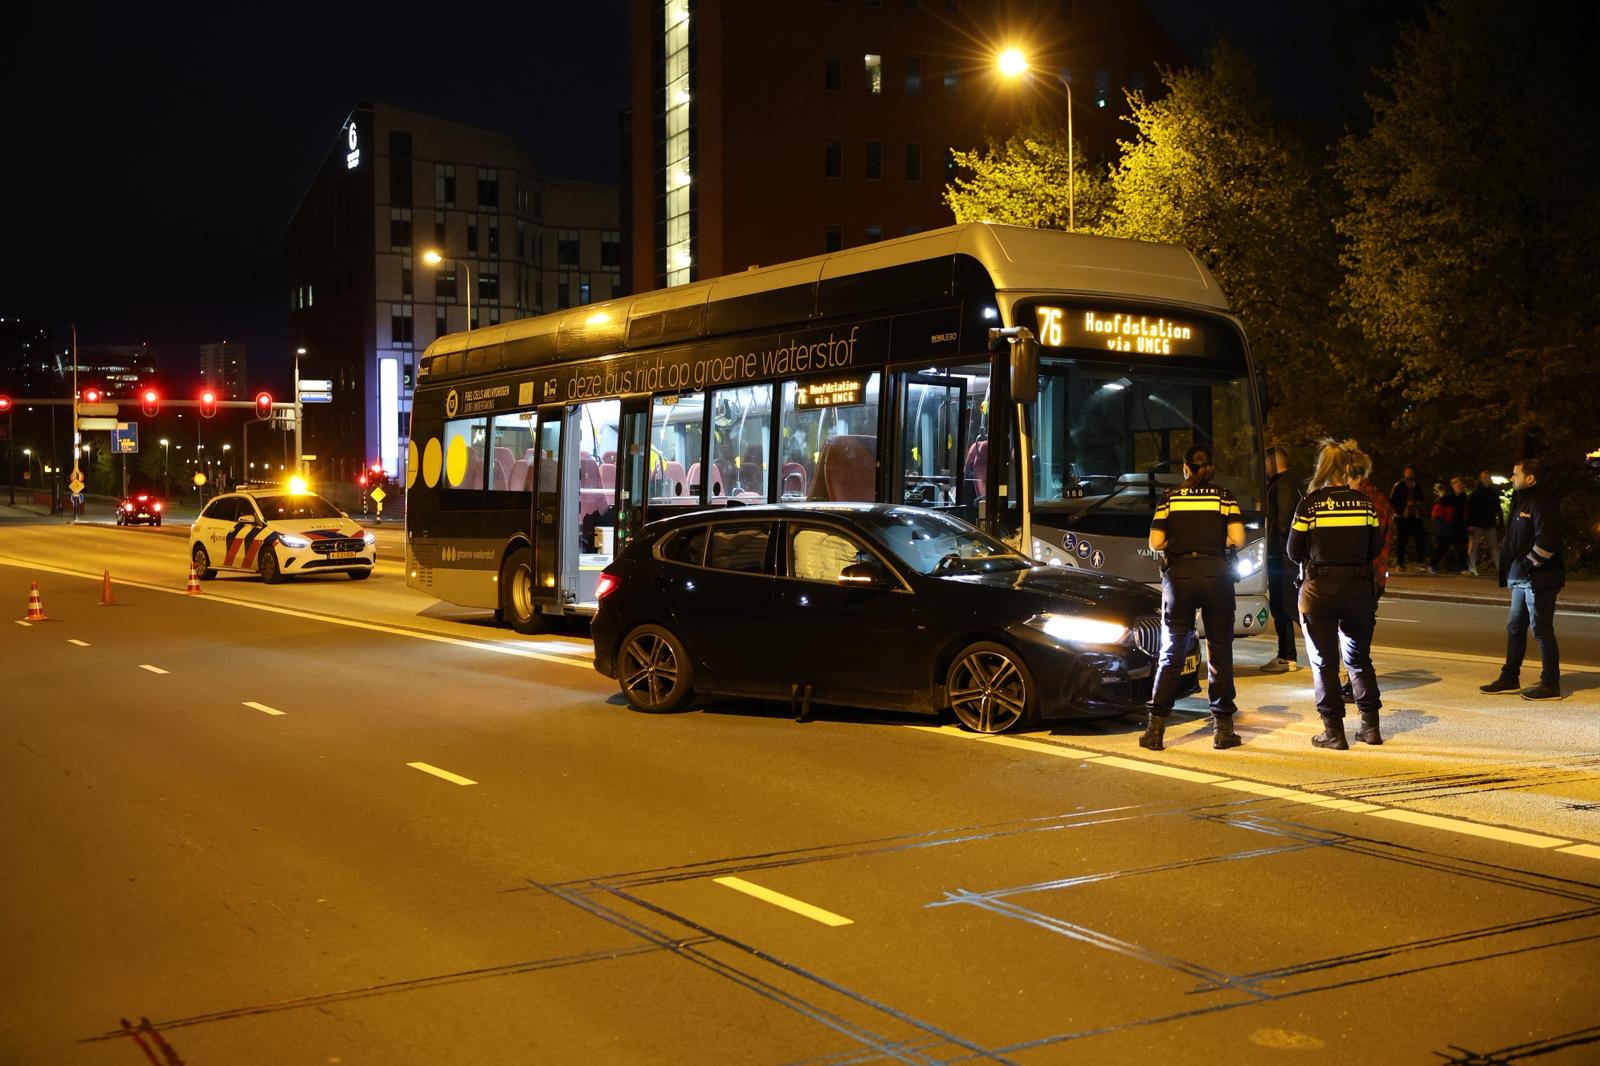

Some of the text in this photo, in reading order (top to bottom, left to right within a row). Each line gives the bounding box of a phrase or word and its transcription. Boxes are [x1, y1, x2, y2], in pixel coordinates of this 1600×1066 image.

[348, 122, 358, 150] 6
[1037, 306, 1191, 347] 76 Hoofdstation
[1107, 337, 1171, 355] via UMCG
[567, 326, 860, 399] deze bus rijdt op groene waterstof
[809, 380, 859, 395] Hoofdstation
[814, 391, 854, 405] via UMCG
[1321, 498, 1362, 510] POLITIE
